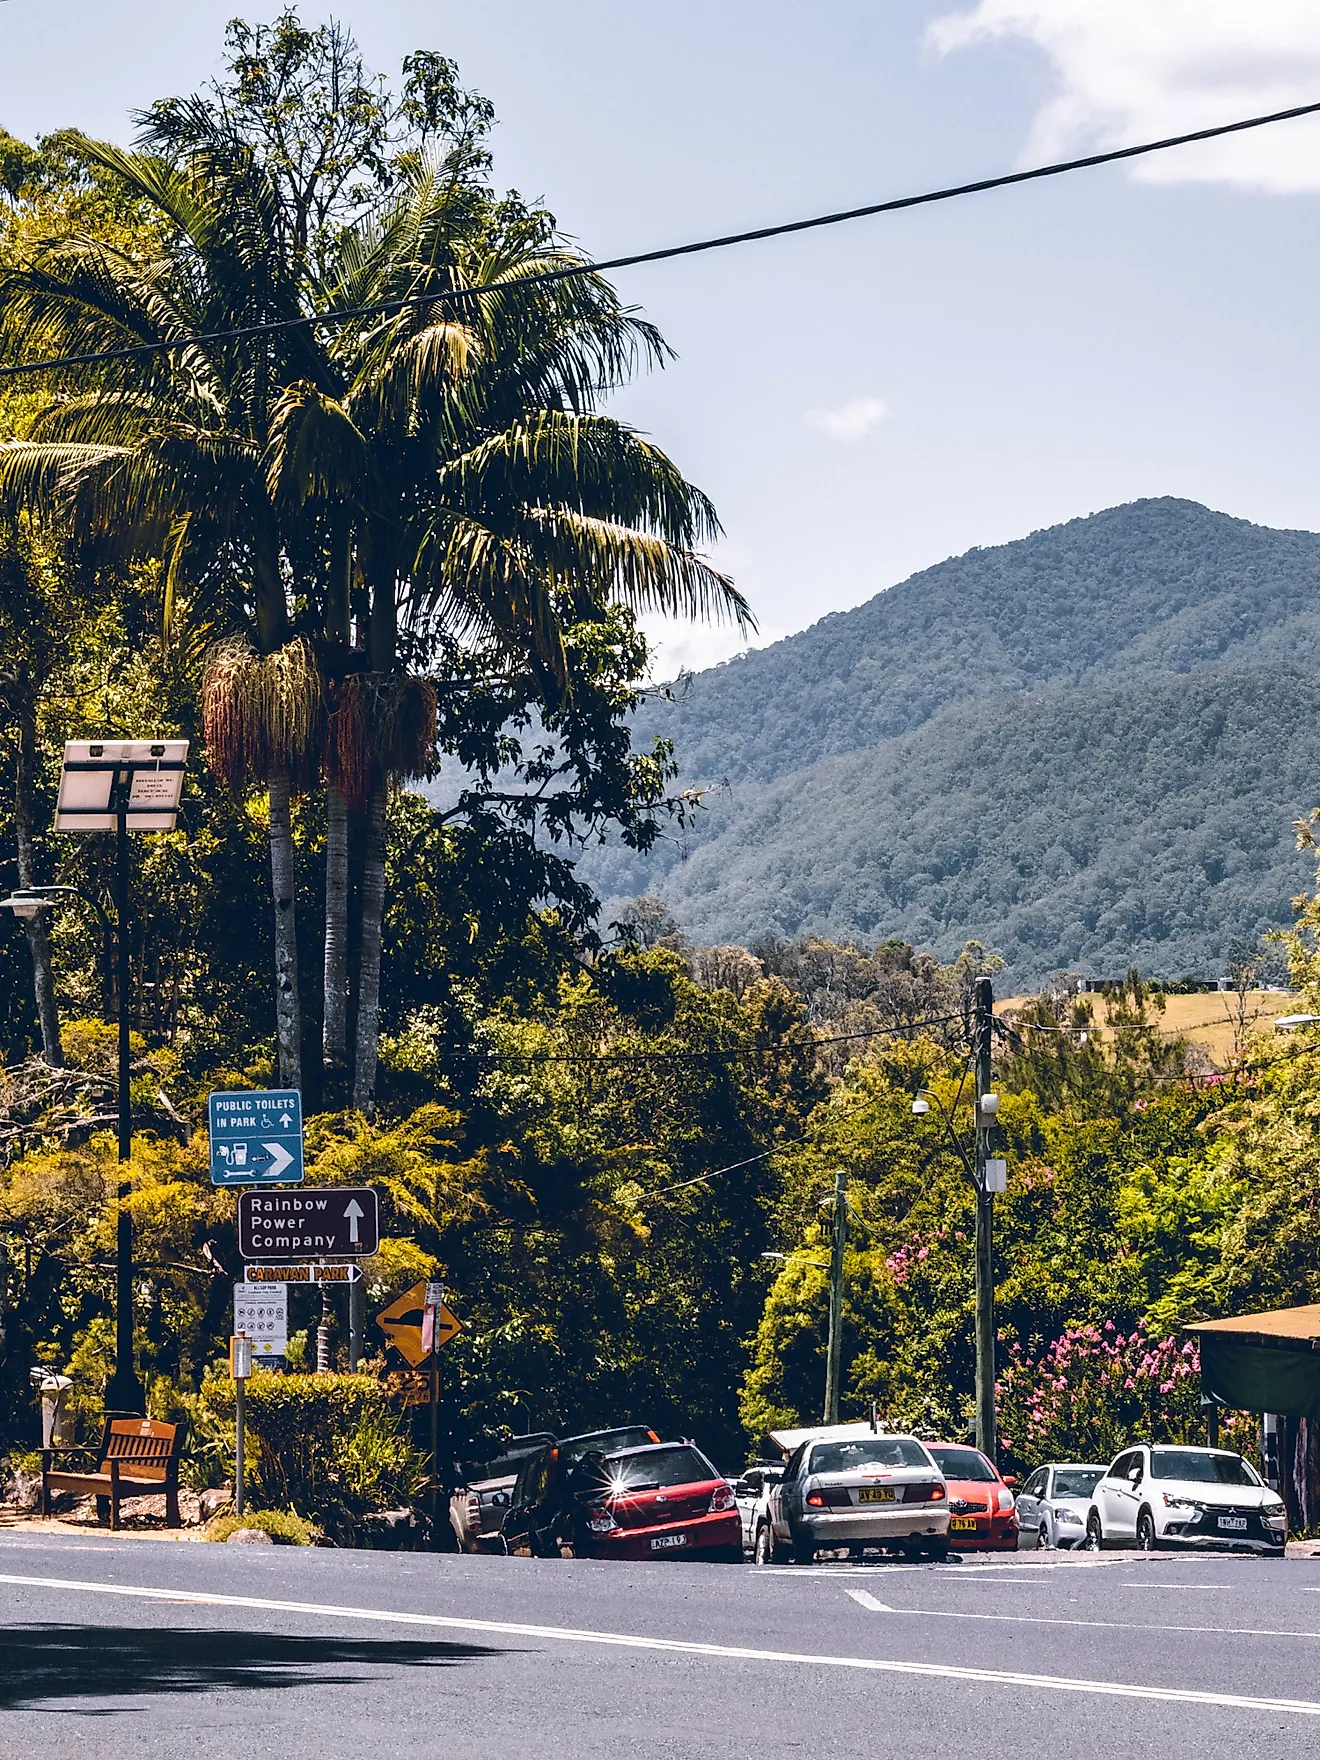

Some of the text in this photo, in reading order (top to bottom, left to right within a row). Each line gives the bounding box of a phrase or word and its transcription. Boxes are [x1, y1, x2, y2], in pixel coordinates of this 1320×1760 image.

[216, 1099, 295, 1111] PUBLIC TOILETS
[216, 1117, 257, 1128] IN PARK
[251, 1198, 328, 1211] Rainbow
[251, 1216, 305, 1229] Power
[251, 1234, 336, 1249] Company
[247, 1266, 349, 1282] CARAVAN PARK
